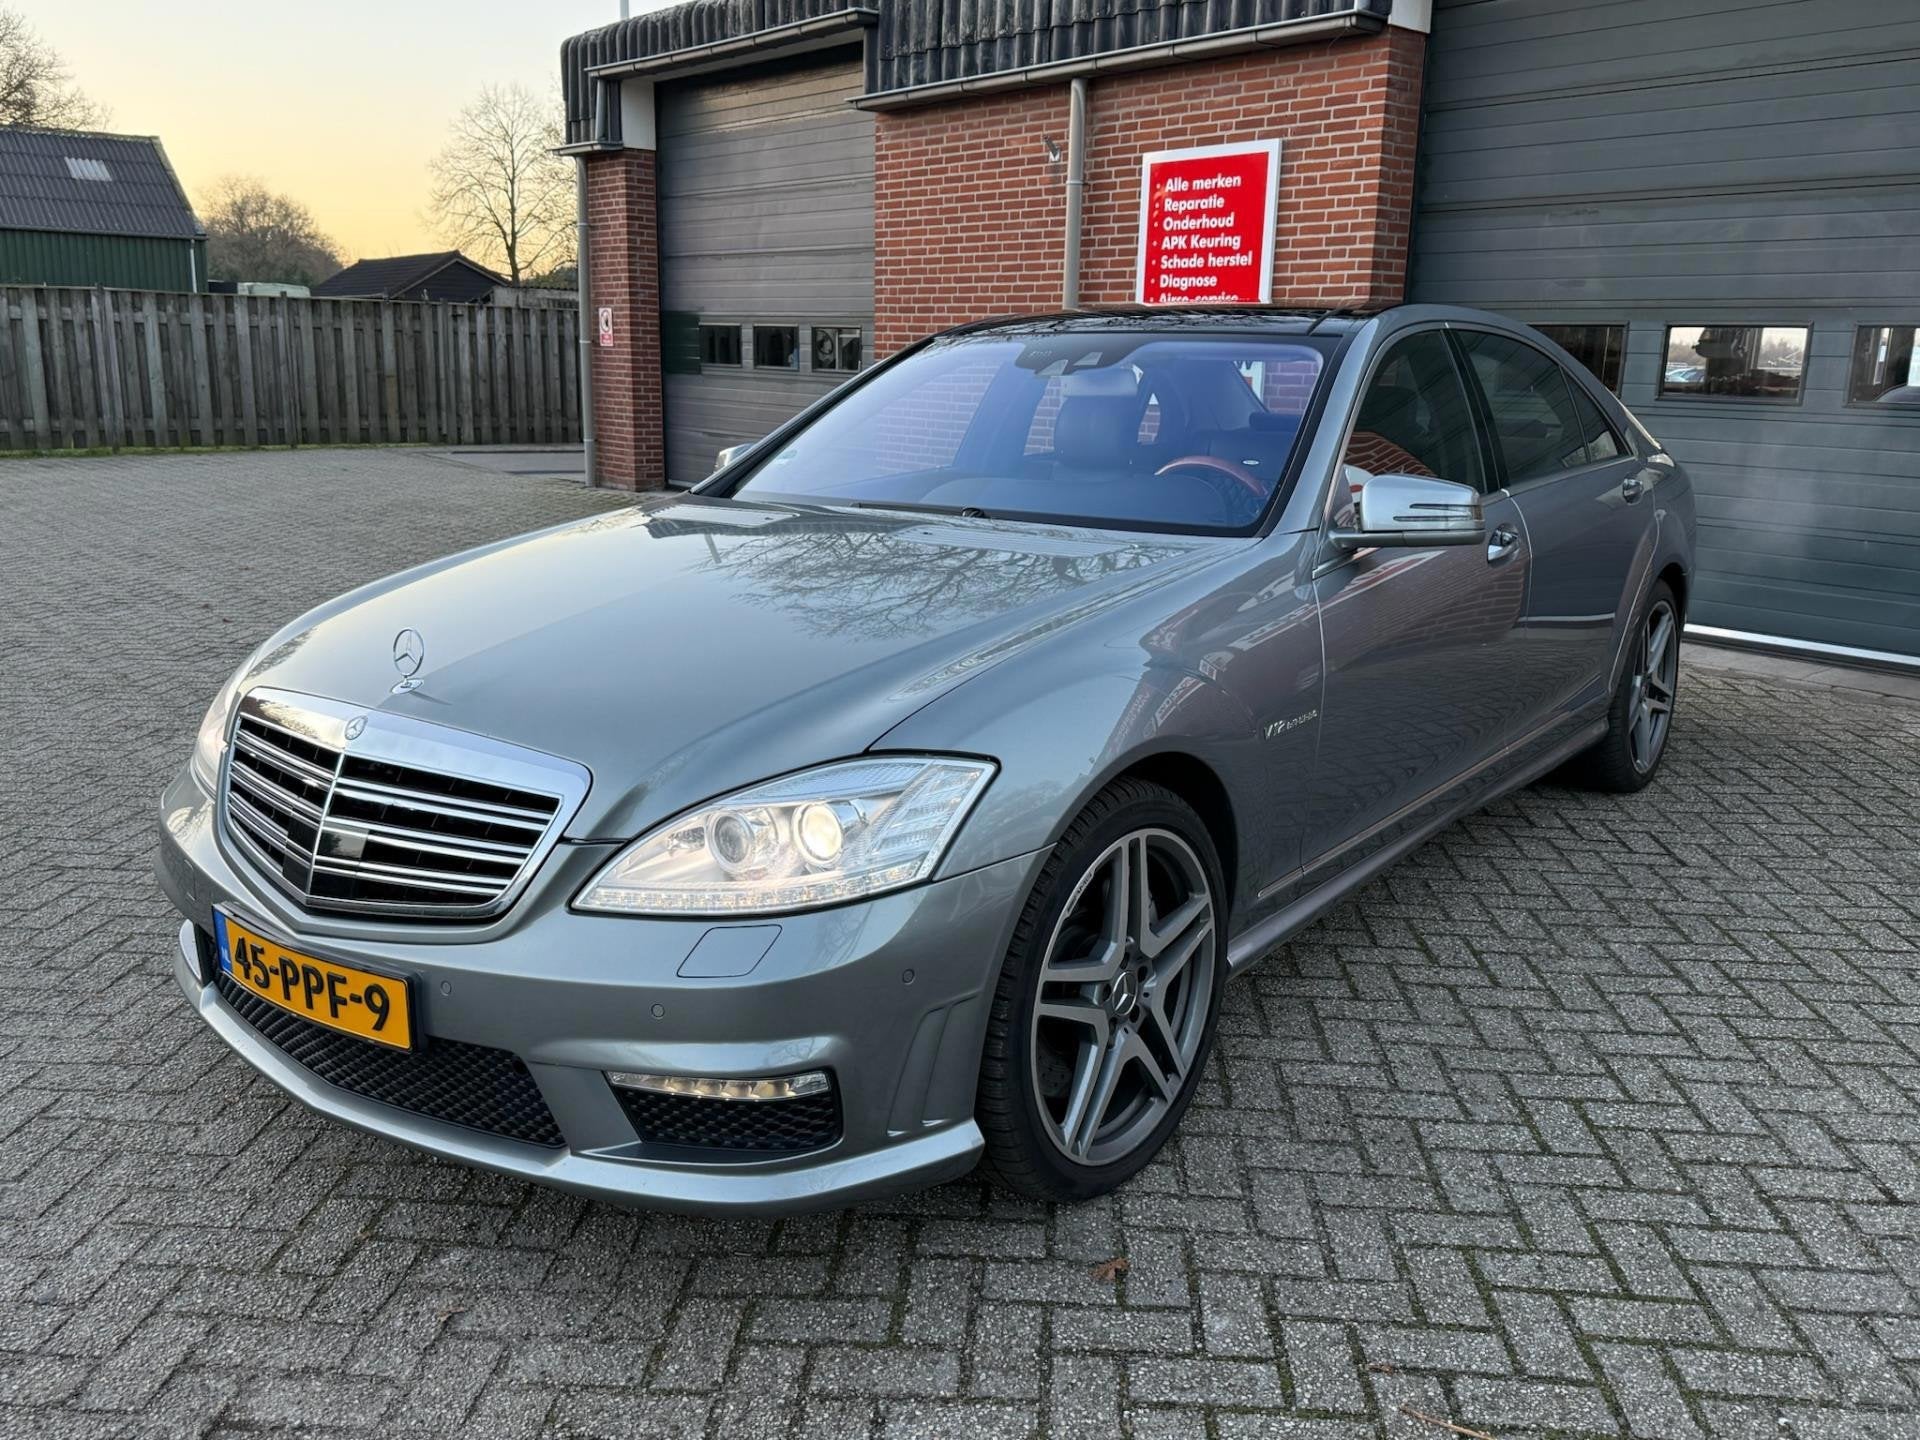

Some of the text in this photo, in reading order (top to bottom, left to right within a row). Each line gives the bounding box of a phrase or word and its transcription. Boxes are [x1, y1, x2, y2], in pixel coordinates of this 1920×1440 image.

[1164, 173, 1242, 192] Alle merken
[1164, 194, 1225, 214] Reparatie
[1163, 212, 1235, 231] Onderhoud
[1161, 233, 1241, 250] APK Keuring
[1160, 251, 1253, 269] Schade herstel
[1160, 274, 1218, 290] Diagnose
[234, 937, 390, 1032] 45-PPF-9
